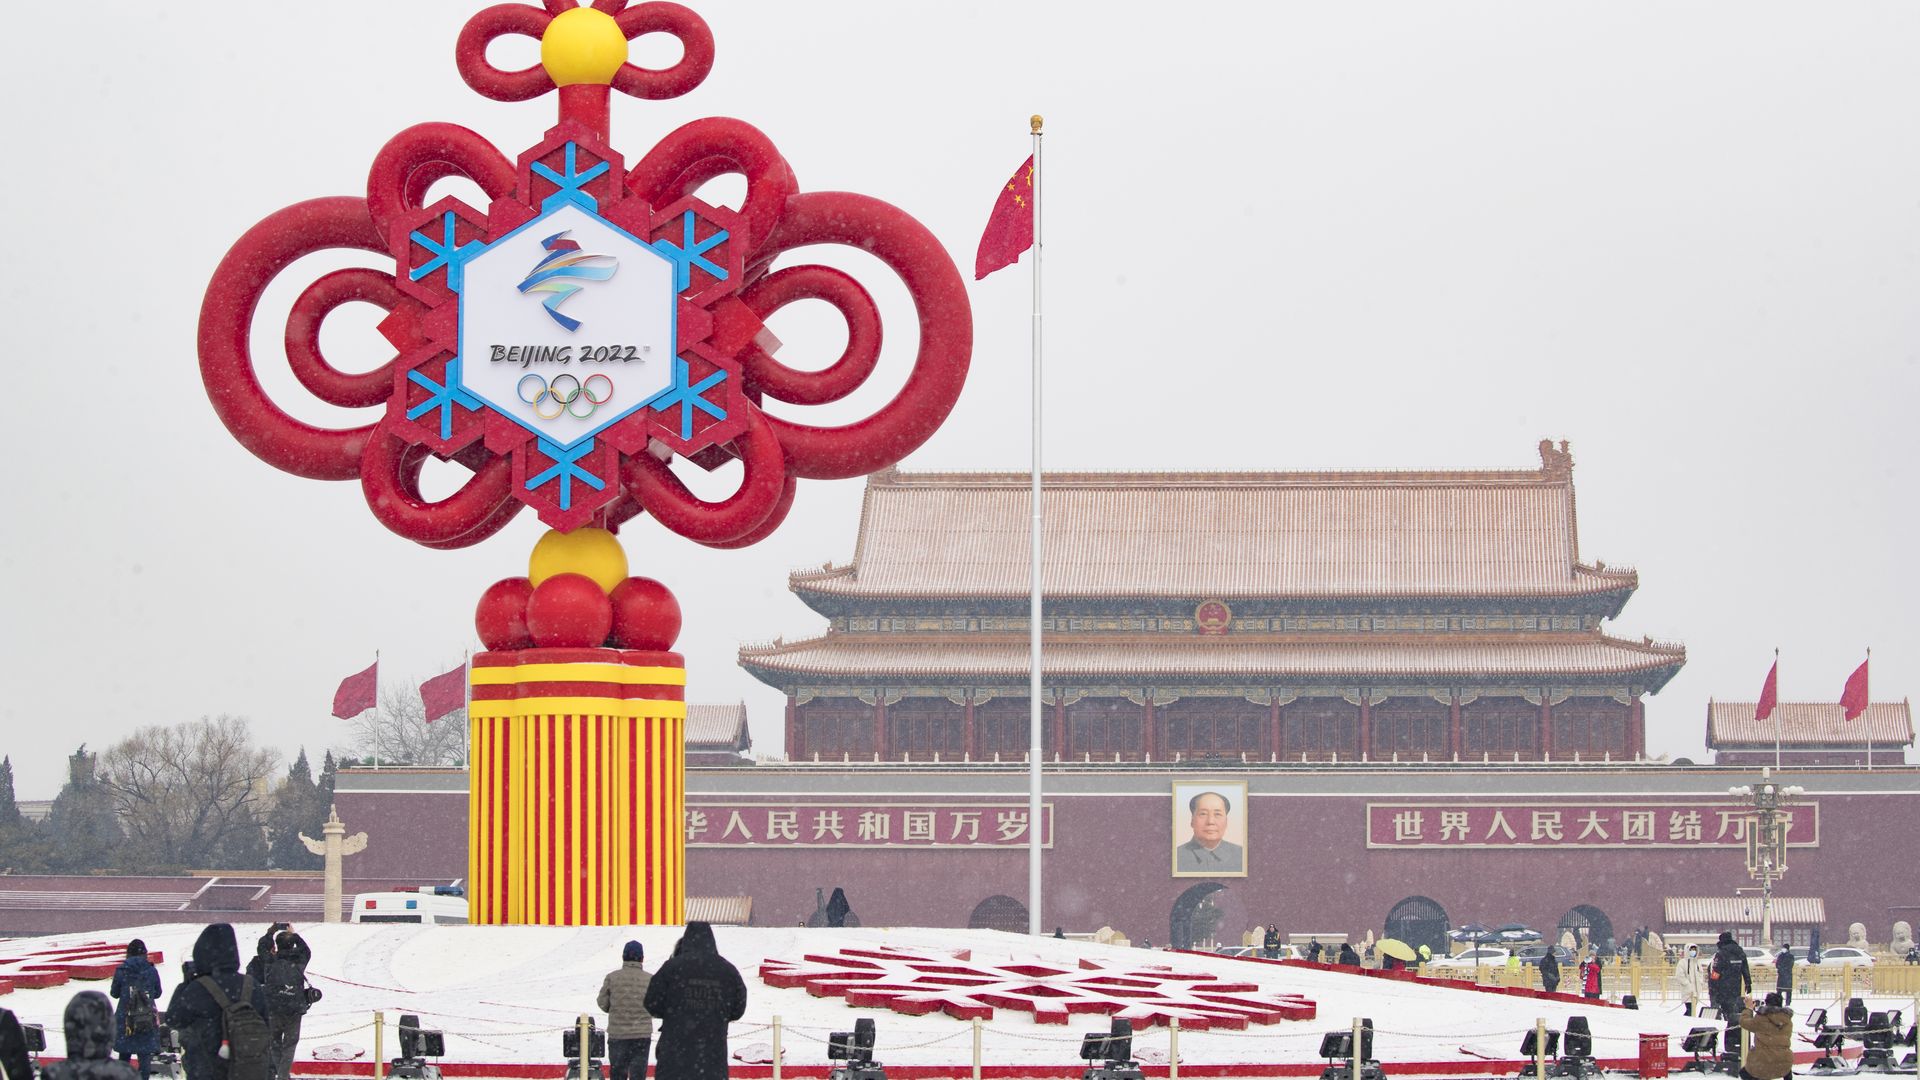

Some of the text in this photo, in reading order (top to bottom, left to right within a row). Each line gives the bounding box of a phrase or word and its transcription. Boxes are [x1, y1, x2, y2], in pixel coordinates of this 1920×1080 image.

[490, 344, 643, 368] BEIJING 2022
[685, 810, 1029, 841] 华人民共和国万岁
